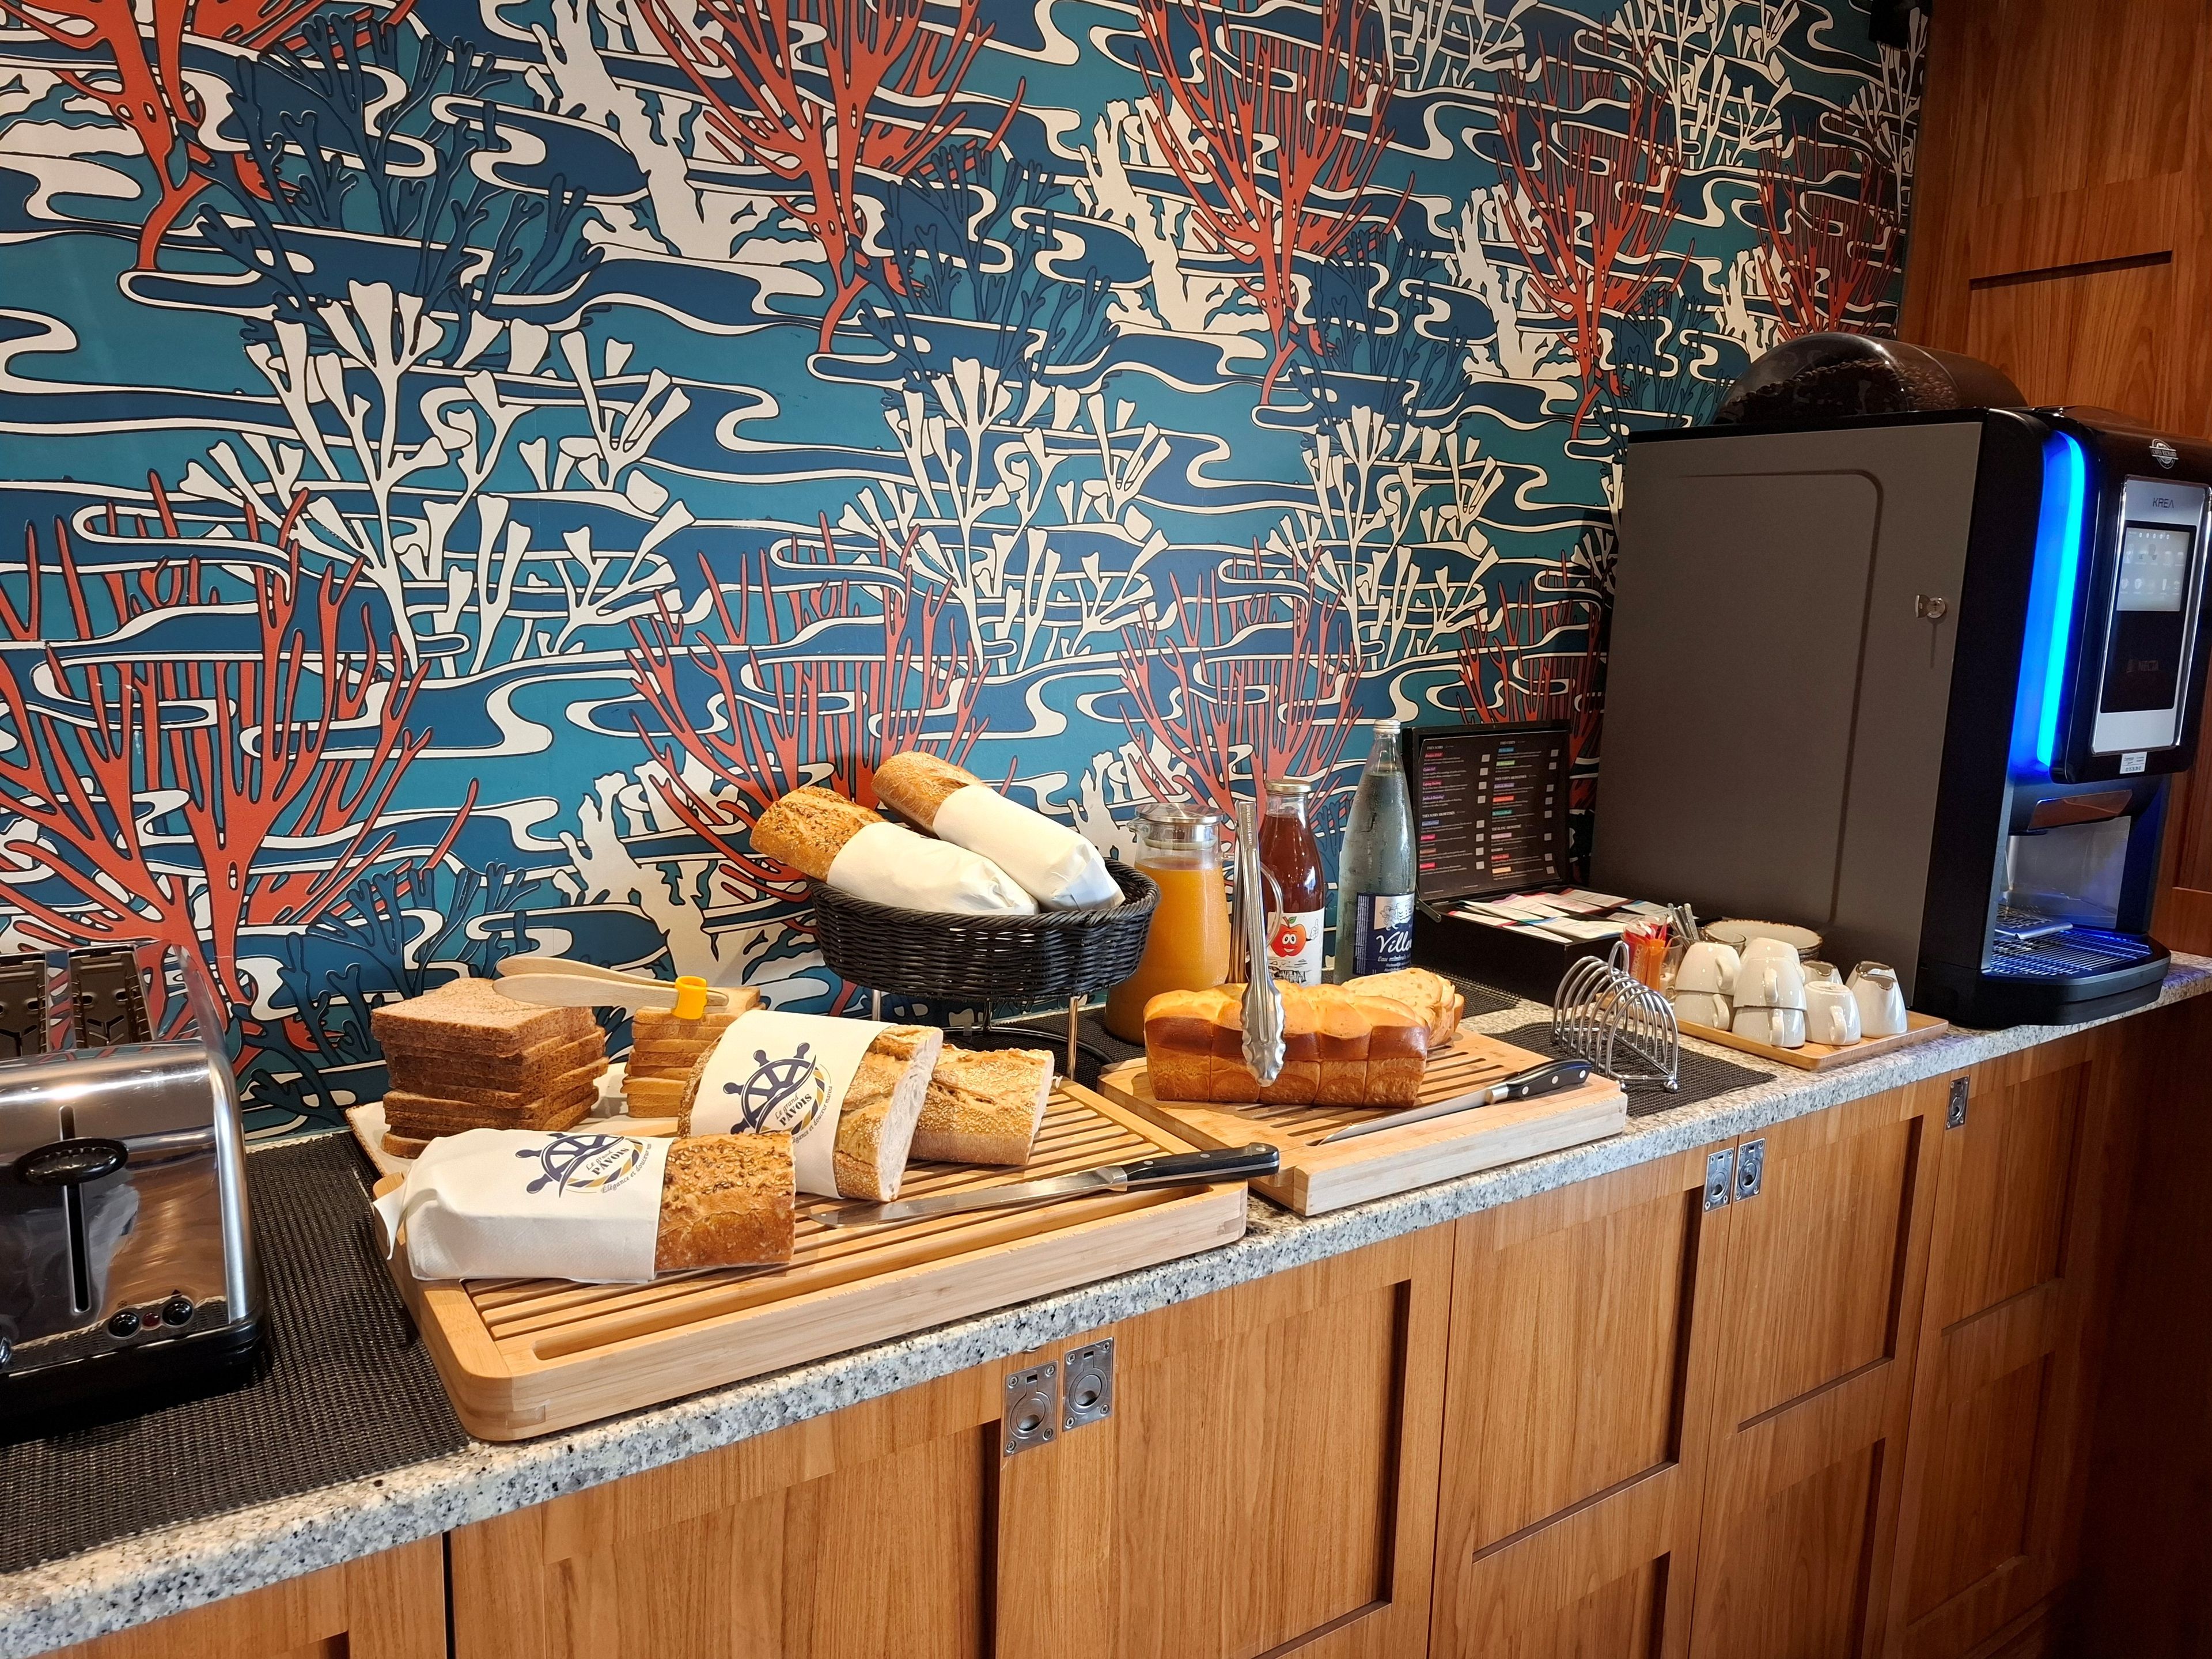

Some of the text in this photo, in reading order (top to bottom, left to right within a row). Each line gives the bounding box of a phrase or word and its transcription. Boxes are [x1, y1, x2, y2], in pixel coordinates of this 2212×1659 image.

[2152, 497, 2175, 509] KREA
[774, 1092, 800, 1120] Le grand
[779, 1093, 812, 1127] PAVOIS
[813, 1104, 827, 1126] douceur
[585, 1149, 613, 1171] Le grand
[591, 1147, 630, 1175] PAVOIS
